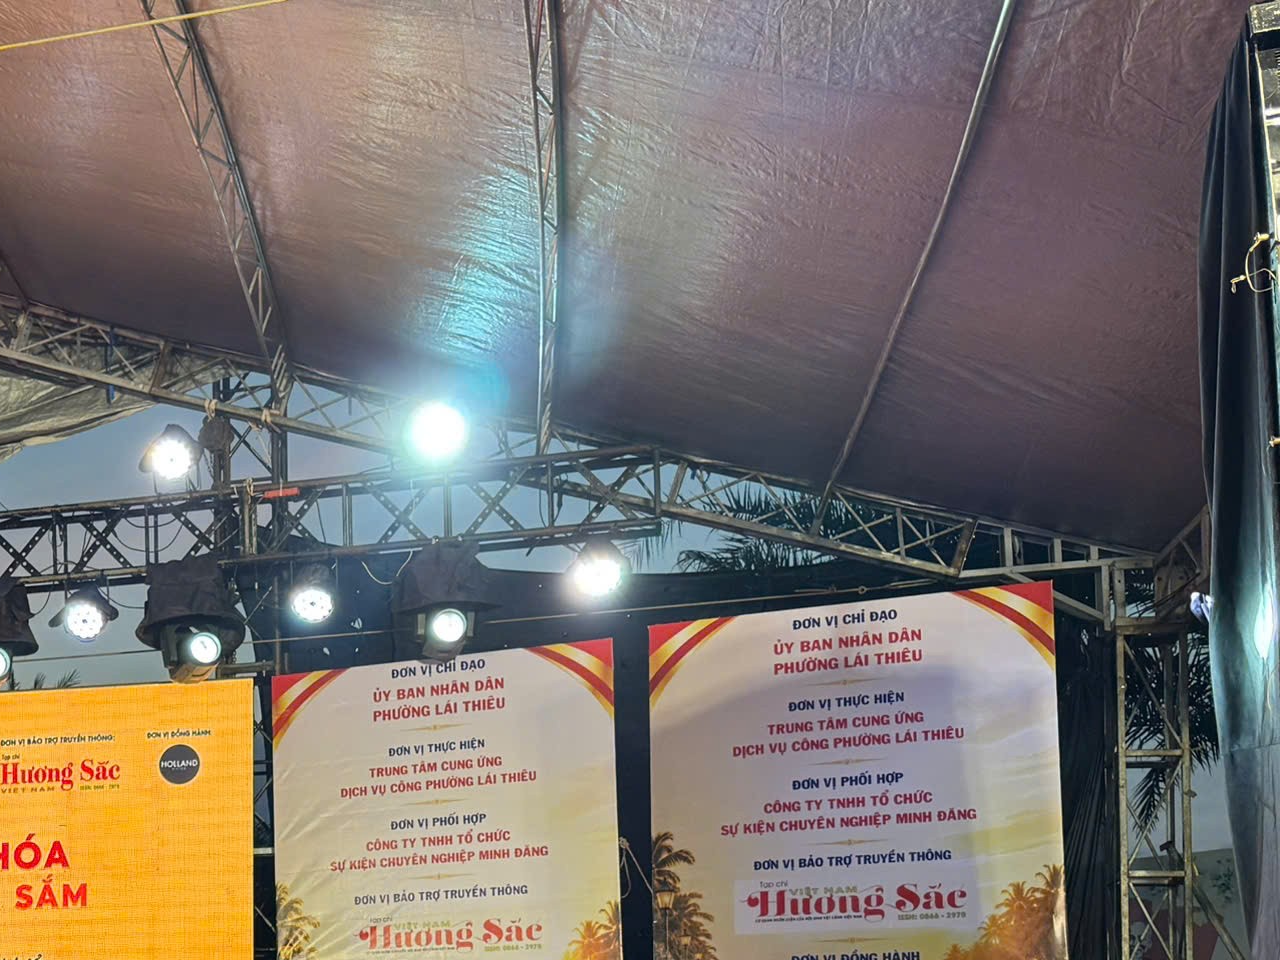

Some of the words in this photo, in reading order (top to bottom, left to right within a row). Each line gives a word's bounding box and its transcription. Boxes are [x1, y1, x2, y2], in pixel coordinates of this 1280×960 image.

[793, 618, 820, 630] ĐƠN
[826, 616, 838, 628] VỊ
[843, 610, 864, 624] CHỈ
[870, 610, 897, 623] ĐẠO
[774, 640, 794, 655] ỦY
[801, 639, 832, 652] BAN
[839, 632, 882, 648] NHÂN
[889, 628, 921, 643] DÂN
[391, 666, 416, 678] ĐƠN
[421, 666, 432, 676] VỊ
[461, 660, 485, 671] ĐẠO
[774, 658, 838, 675] PHƯỜNG
[845, 655, 868, 668] LÁI
[874, 649, 922, 664] THIÊU
[373, 688, 390, 702] ỦY
[398, 686, 425, 699] BAN
[430, 678, 469, 696] NHÂN
[476, 676, 504, 691] DÂN
[789, 700, 814, 711] ĐƠN
[819, 699, 831, 710] VỊ
[836, 695, 870, 708] THỰC
[875, 691, 904, 703] HIỆN
[373, 706, 430, 721] PHƯỜNG
[436, 700, 457, 716] LÁI
[463, 696, 505, 713] THIÊU
[768, 722, 813, 734] TRUNG
[818, 718, 847, 730] TÂM
[853, 715, 890, 727] CUNG
[895, 710, 924, 724] ỨNG
[733, 745, 764, 758] DỊCH
[770, 743, 786, 755] VỤ
[792, 739, 829, 751] CÔNG
[834, 733, 890, 747] PHƯỜNG
[896, 730, 917, 742] LÁI
[923, 726, 964, 741] THIÊU
[0, 761, 74, 791] Hương
[80, 759, 120, 781] Sắc
[161, 759, 198, 768] HOLLAND
[792, 780, 819, 790] ĐƠN
[824, 778, 836, 789] VỊ
[841, 773, 871, 787] PHỐI
[877, 773, 903, 784] HỢP
[764, 801, 800, 813] CÔNG
[805, 800, 822, 810] TY
[828, 797, 865, 809] TNHH
[871, 789, 888, 806] TỔ
[894, 791, 932, 804] CHỨC
[721, 823, 739, 837] SỰ
[744, 820, 775, 835] KIỆN
[780, 816, 835, 831] CHUYÊN
[841, 815, 891, 828] NGHIỆP
[897, 811, 932, 823] MINH
[938, 809, 977, 821] ĐĂNG
[754, 860, 779, 870] ĐƠN
[783, 859, 794, 870] VỊ
[799, 856, 823, 868] BẢO
[827, 855, 852, 866] TRỢ
[856, 849, 905, 864] TRUYỀN
[909, 850, 951, 862] THÔNG
[16, 874, 88, 910] SẮM
[747, 885, 885, 923] Hương
[896, 883, 968, 912] Sắc
